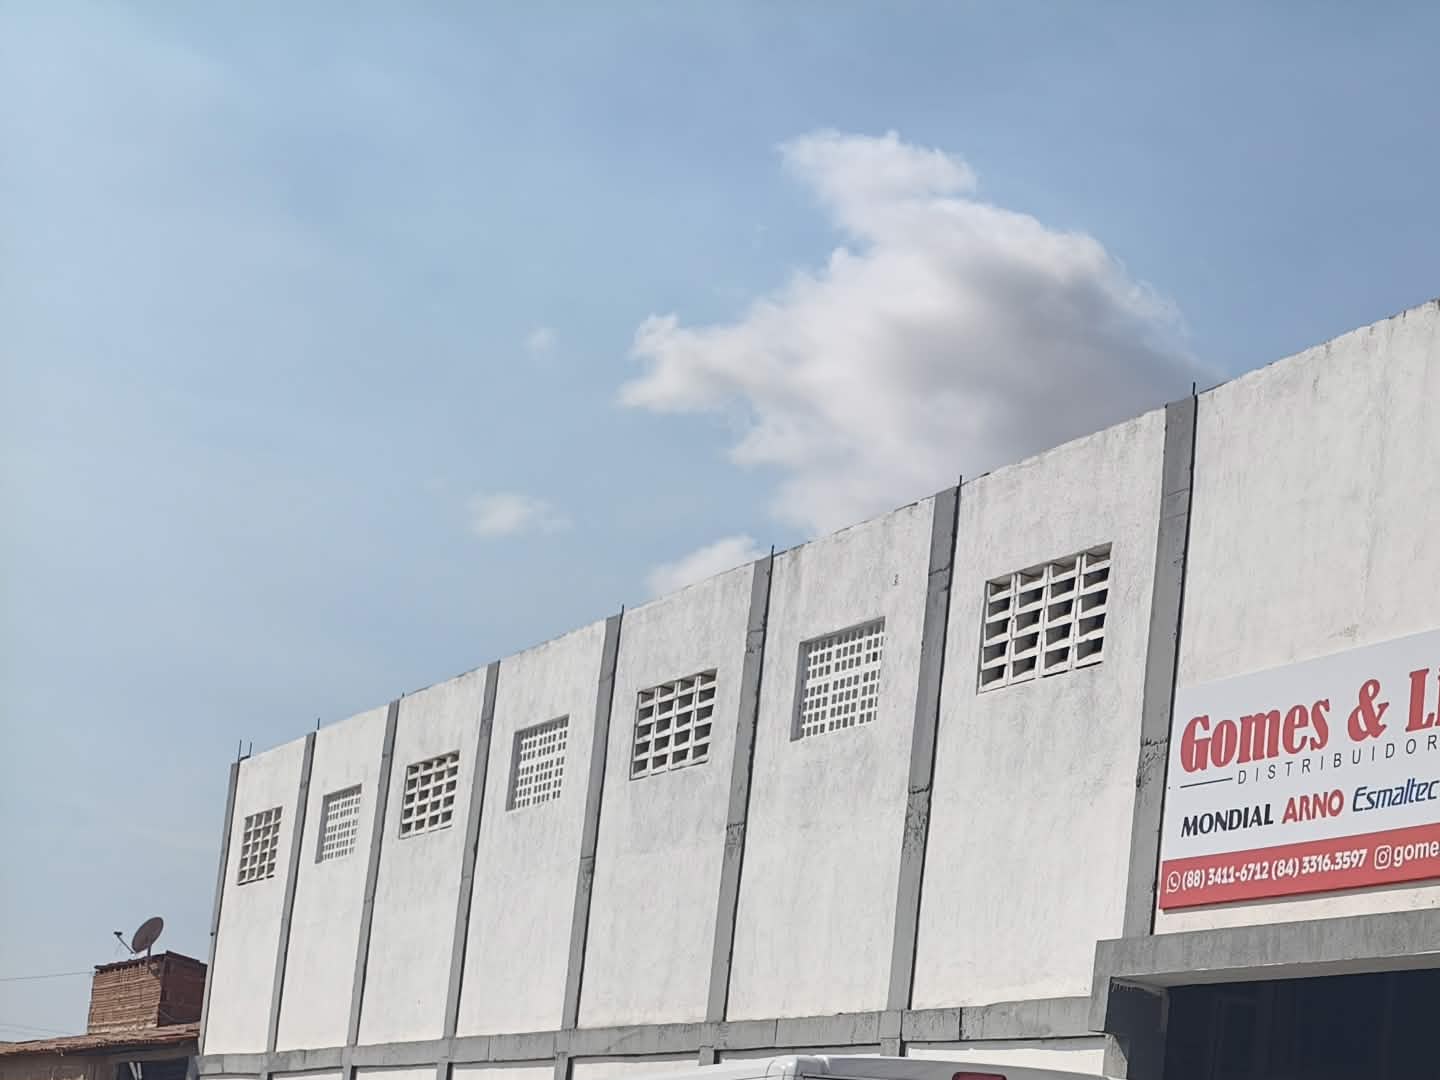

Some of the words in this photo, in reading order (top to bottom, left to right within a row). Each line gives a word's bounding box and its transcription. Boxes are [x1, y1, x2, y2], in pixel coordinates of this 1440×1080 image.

[1180, 699, 1330, 773] Gomes
[1347, 679, 1390, 742] &
[1181, 804, 1274, 838] MONDIAL
[1282, 789, 1345, 824] ARNO
[1352, 778, 1440, 812] Esmaltec
[1182, 866, 1205, 889] (88)
[1207, 862, 1269, 886] 3411-6712
[1272, 857, 1299, 880] (84)
[1301, 848, 1368, 873] 3316.3597
